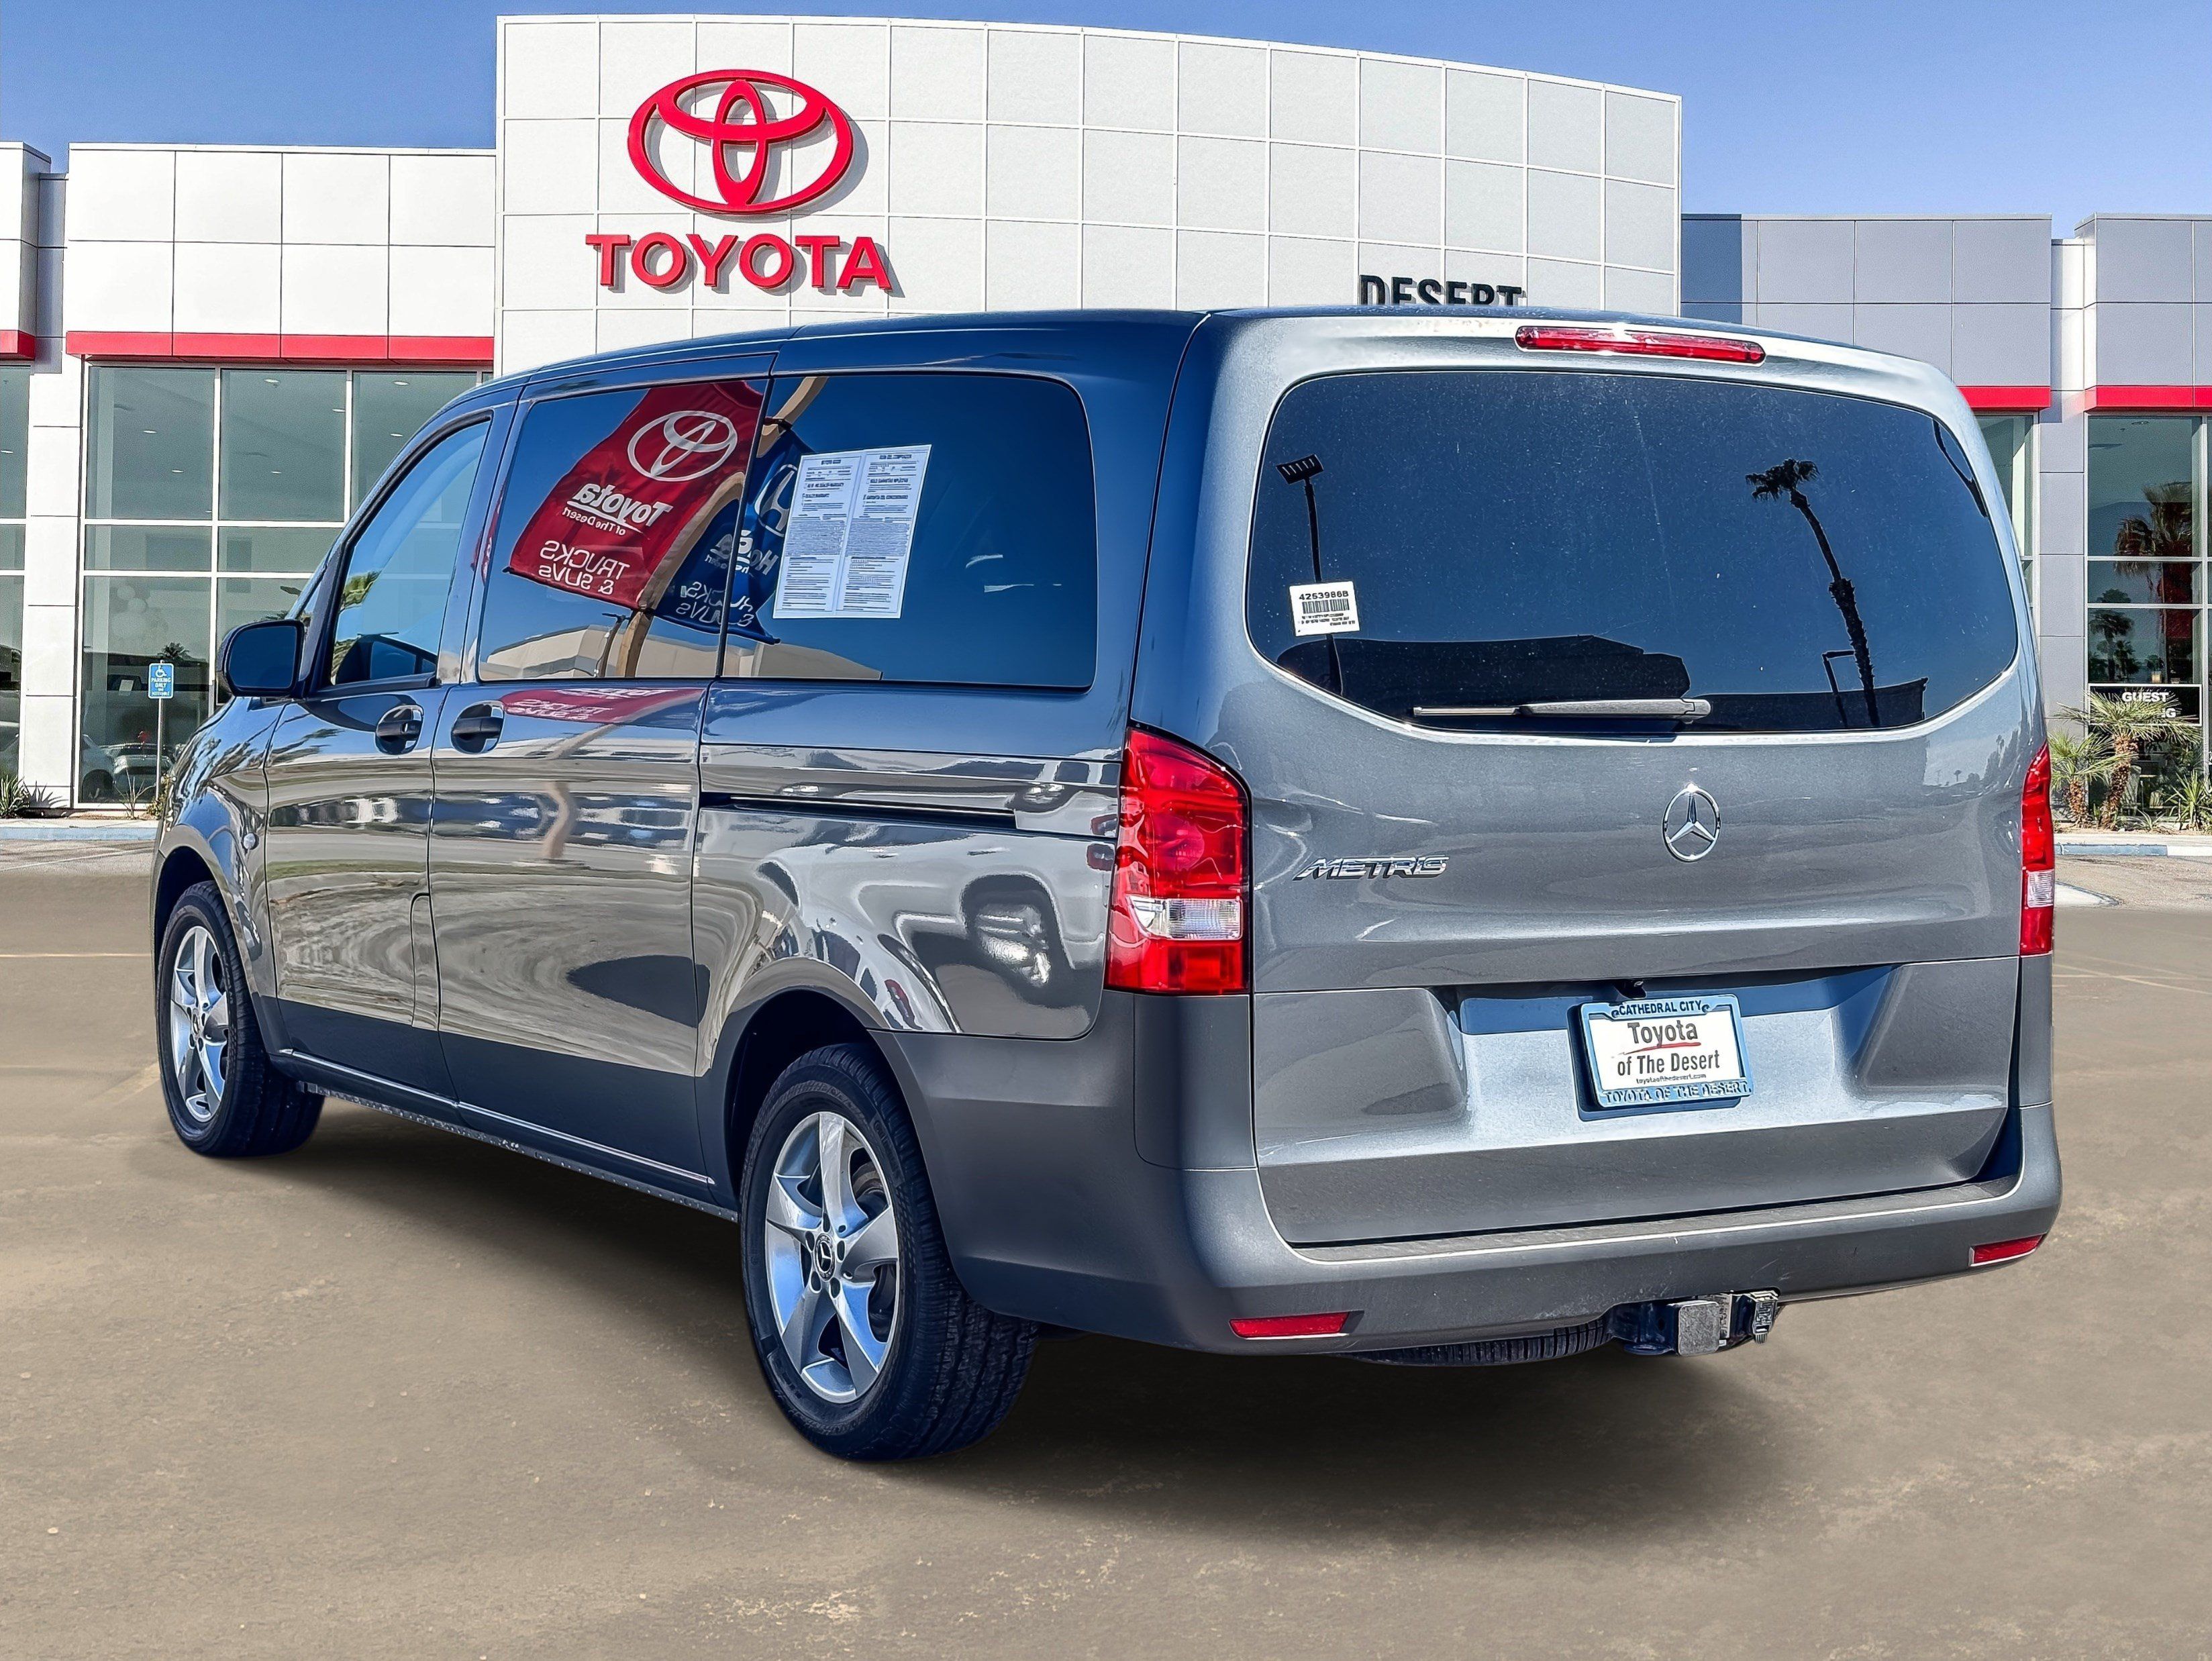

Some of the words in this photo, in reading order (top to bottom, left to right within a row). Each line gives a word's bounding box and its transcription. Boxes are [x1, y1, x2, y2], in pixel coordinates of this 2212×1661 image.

[585, 232, 892, 290] TOYOTA
[1360, 274, 1522, 306] DESERT
[2121, 691, 2169, 703] GUEST
[1293, 855, 1450, 880] METRIS
[1619, 1002, 1678, 1015] CATHEDRAL
[1681, 1000, 1702, 1011] CITY
[1627, 1019, 1698, 1047] Toyota
[1617, 1056, 1632, 1076] of
[1636, 1055, 1664, 1074] The
[1670, 1050, 1720, 1072] Desert
[1604, 1089, 1652, 1103] TOYOTA
[1656, 1087, 1671, 1099] OF
[1674, 1085, 1699, 1098] THE
[1702, 1081, 1748, 1096] DESERT
